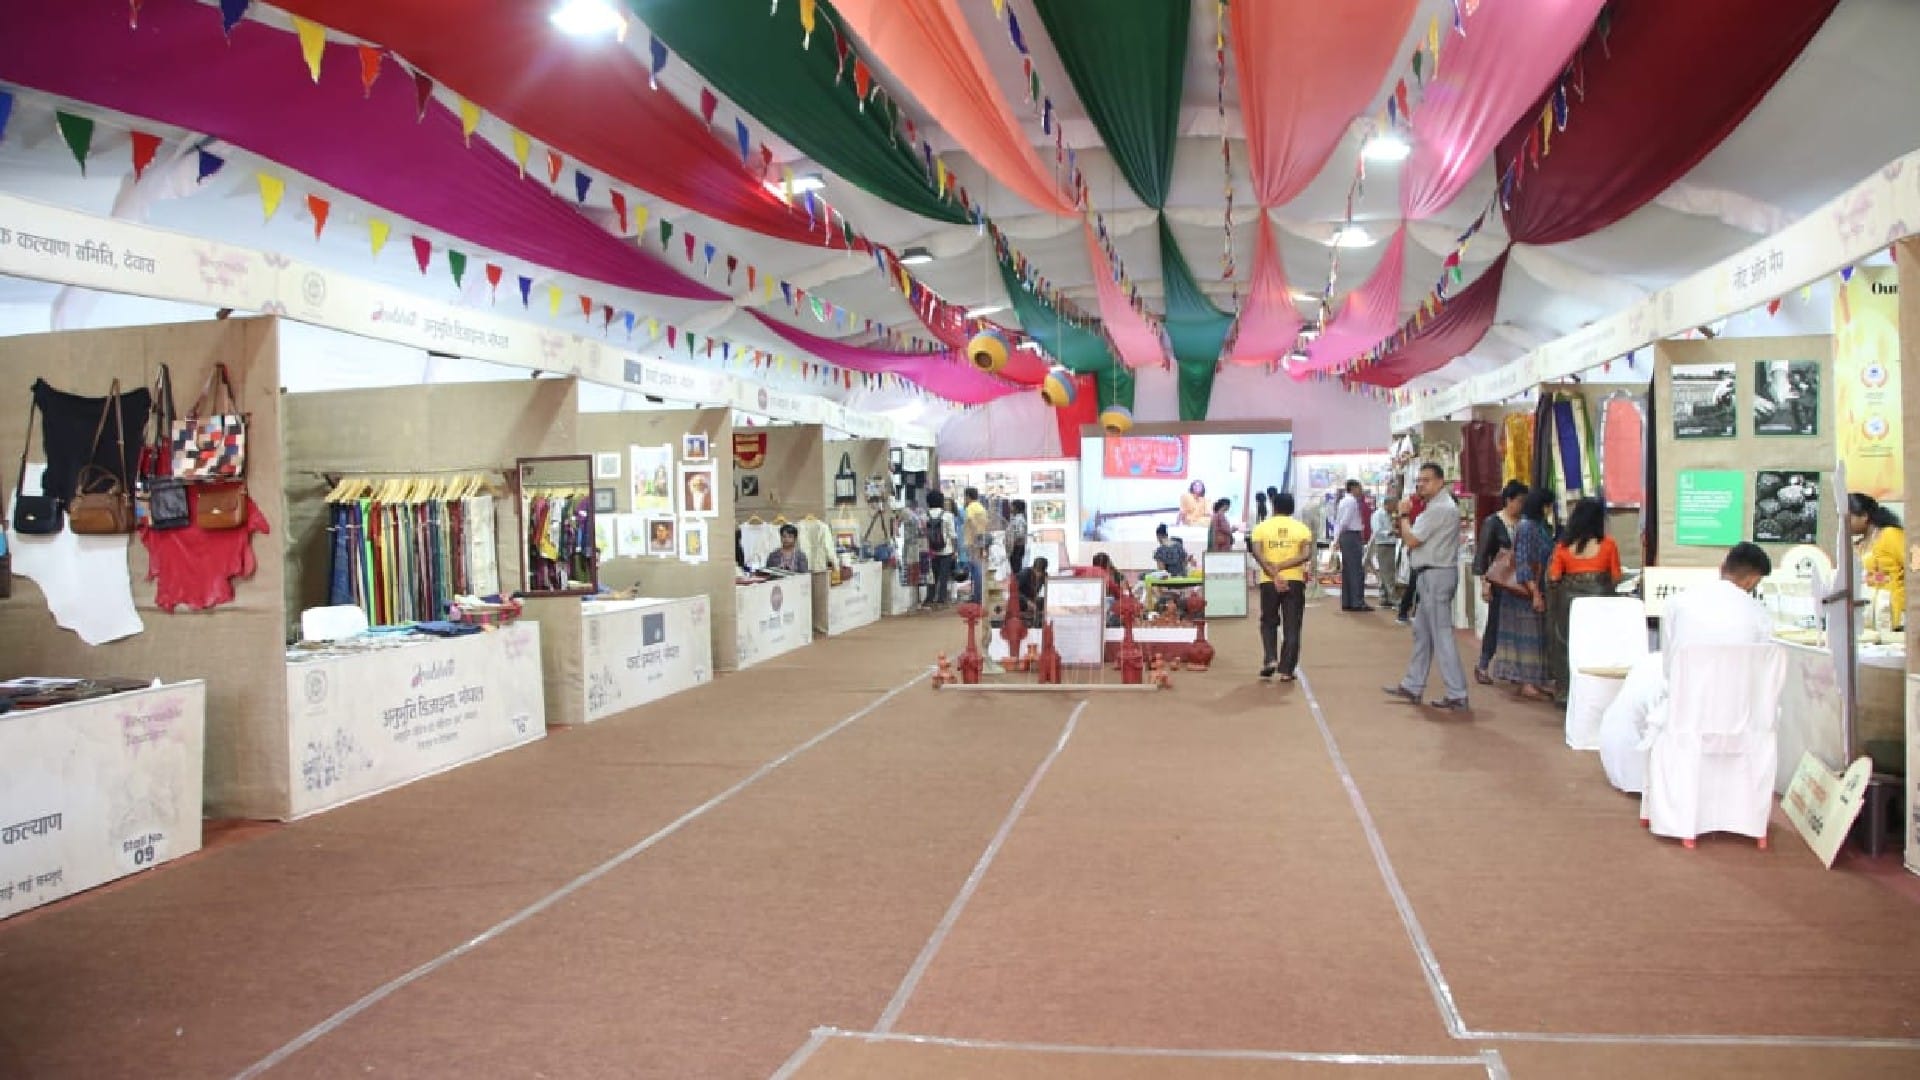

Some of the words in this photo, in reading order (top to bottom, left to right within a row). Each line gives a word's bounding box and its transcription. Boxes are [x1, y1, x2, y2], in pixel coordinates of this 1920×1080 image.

[16, 231, 70, 258] कल्याण
[123, 248, 156, 274] देवास
[1, 812, 62, 844] कल्याण
[134, 846, 155, 864] 09
